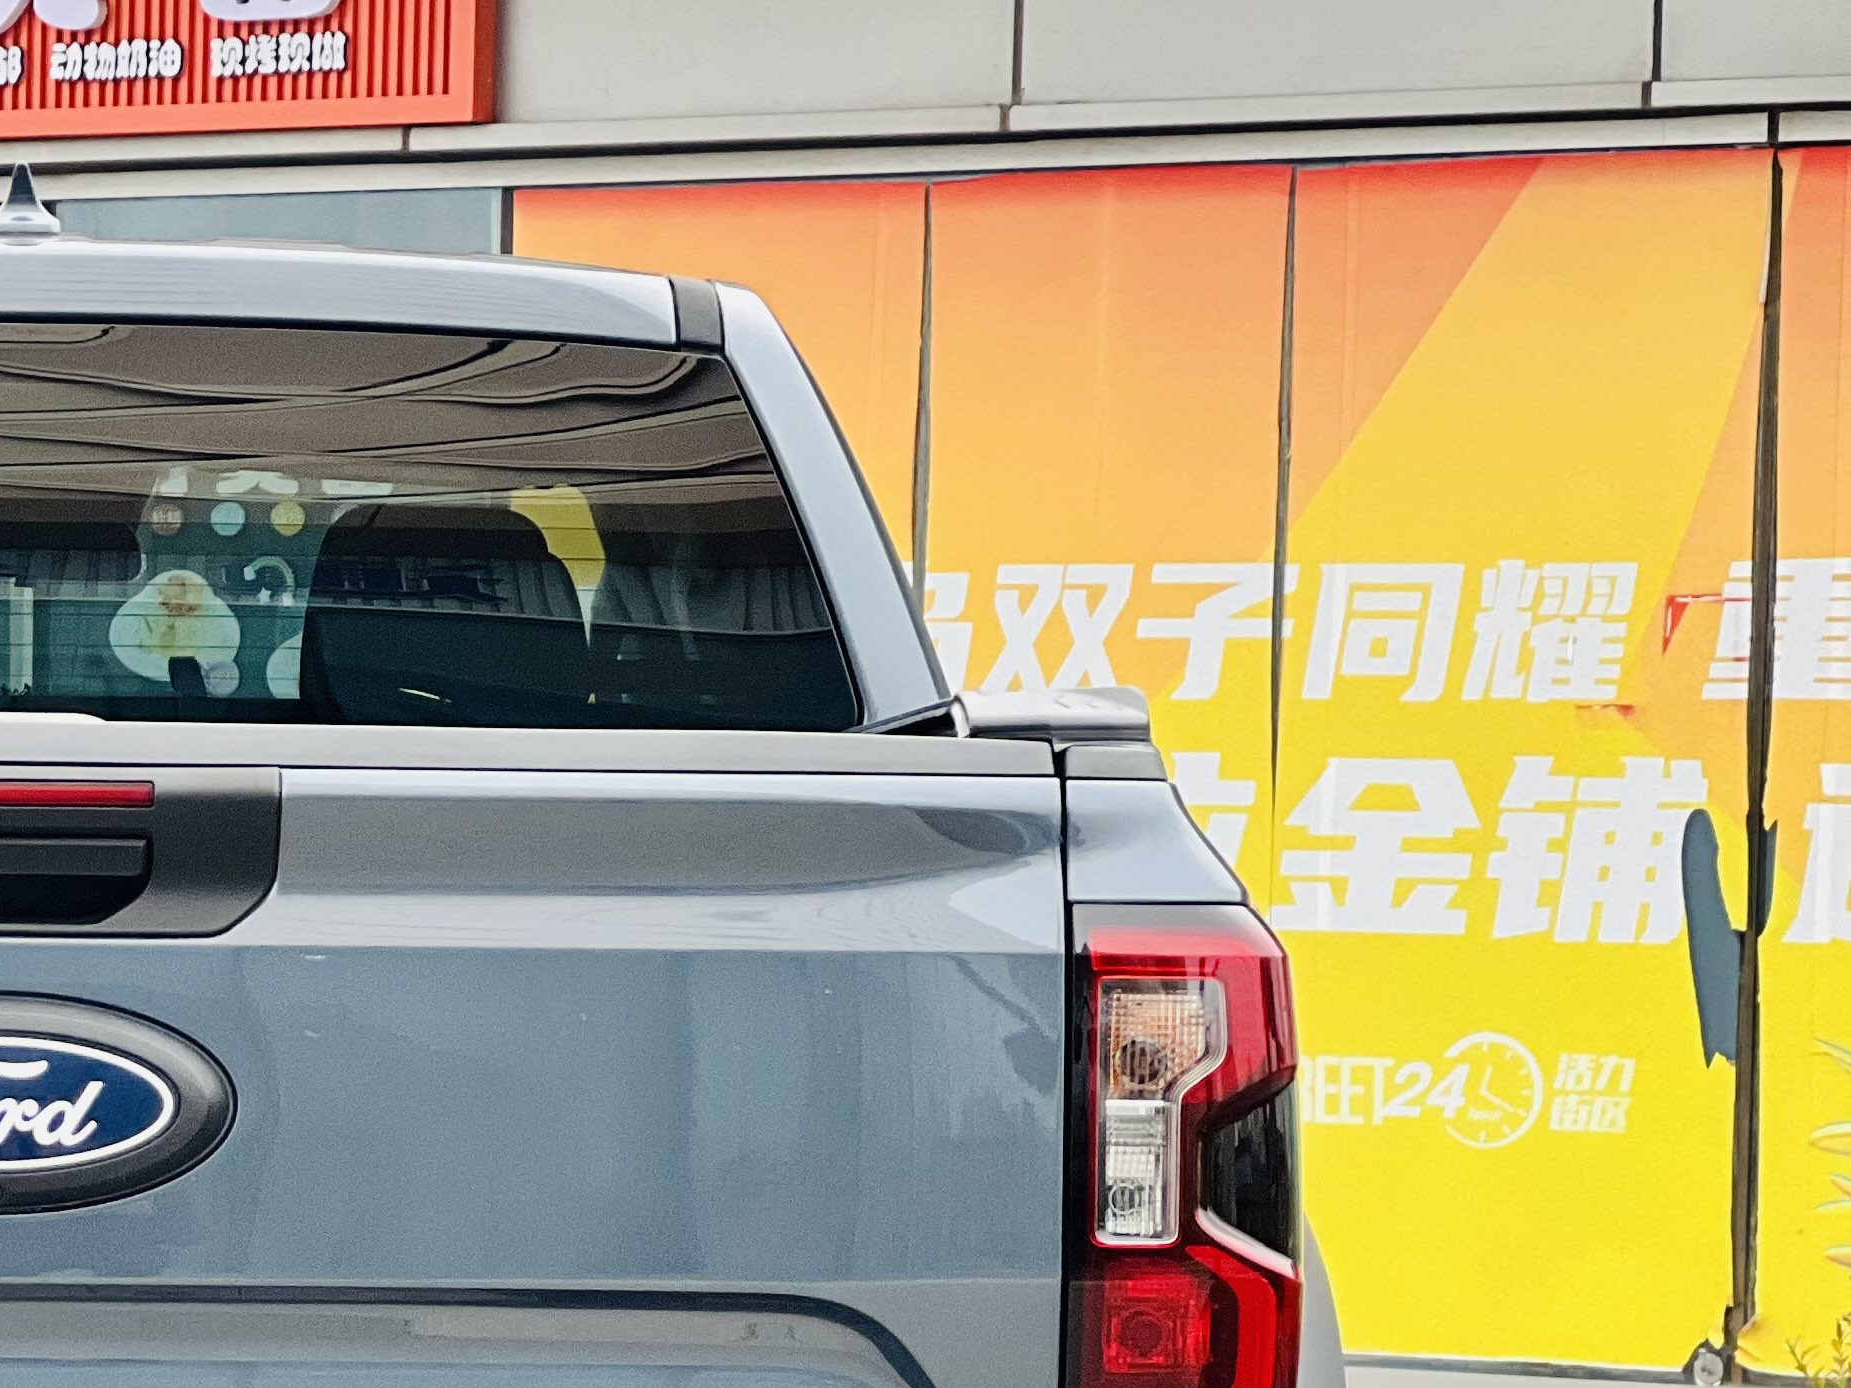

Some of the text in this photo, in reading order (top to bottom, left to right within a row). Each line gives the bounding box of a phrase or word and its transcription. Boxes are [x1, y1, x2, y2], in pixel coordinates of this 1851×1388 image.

[50, 38, 182, 80] 动物奶油
[210, 30, 346, 77] 现烤现做
[1553, 1053, 1636, 1093] 活力
[1549, 1094, 1634, 1133] 街区
